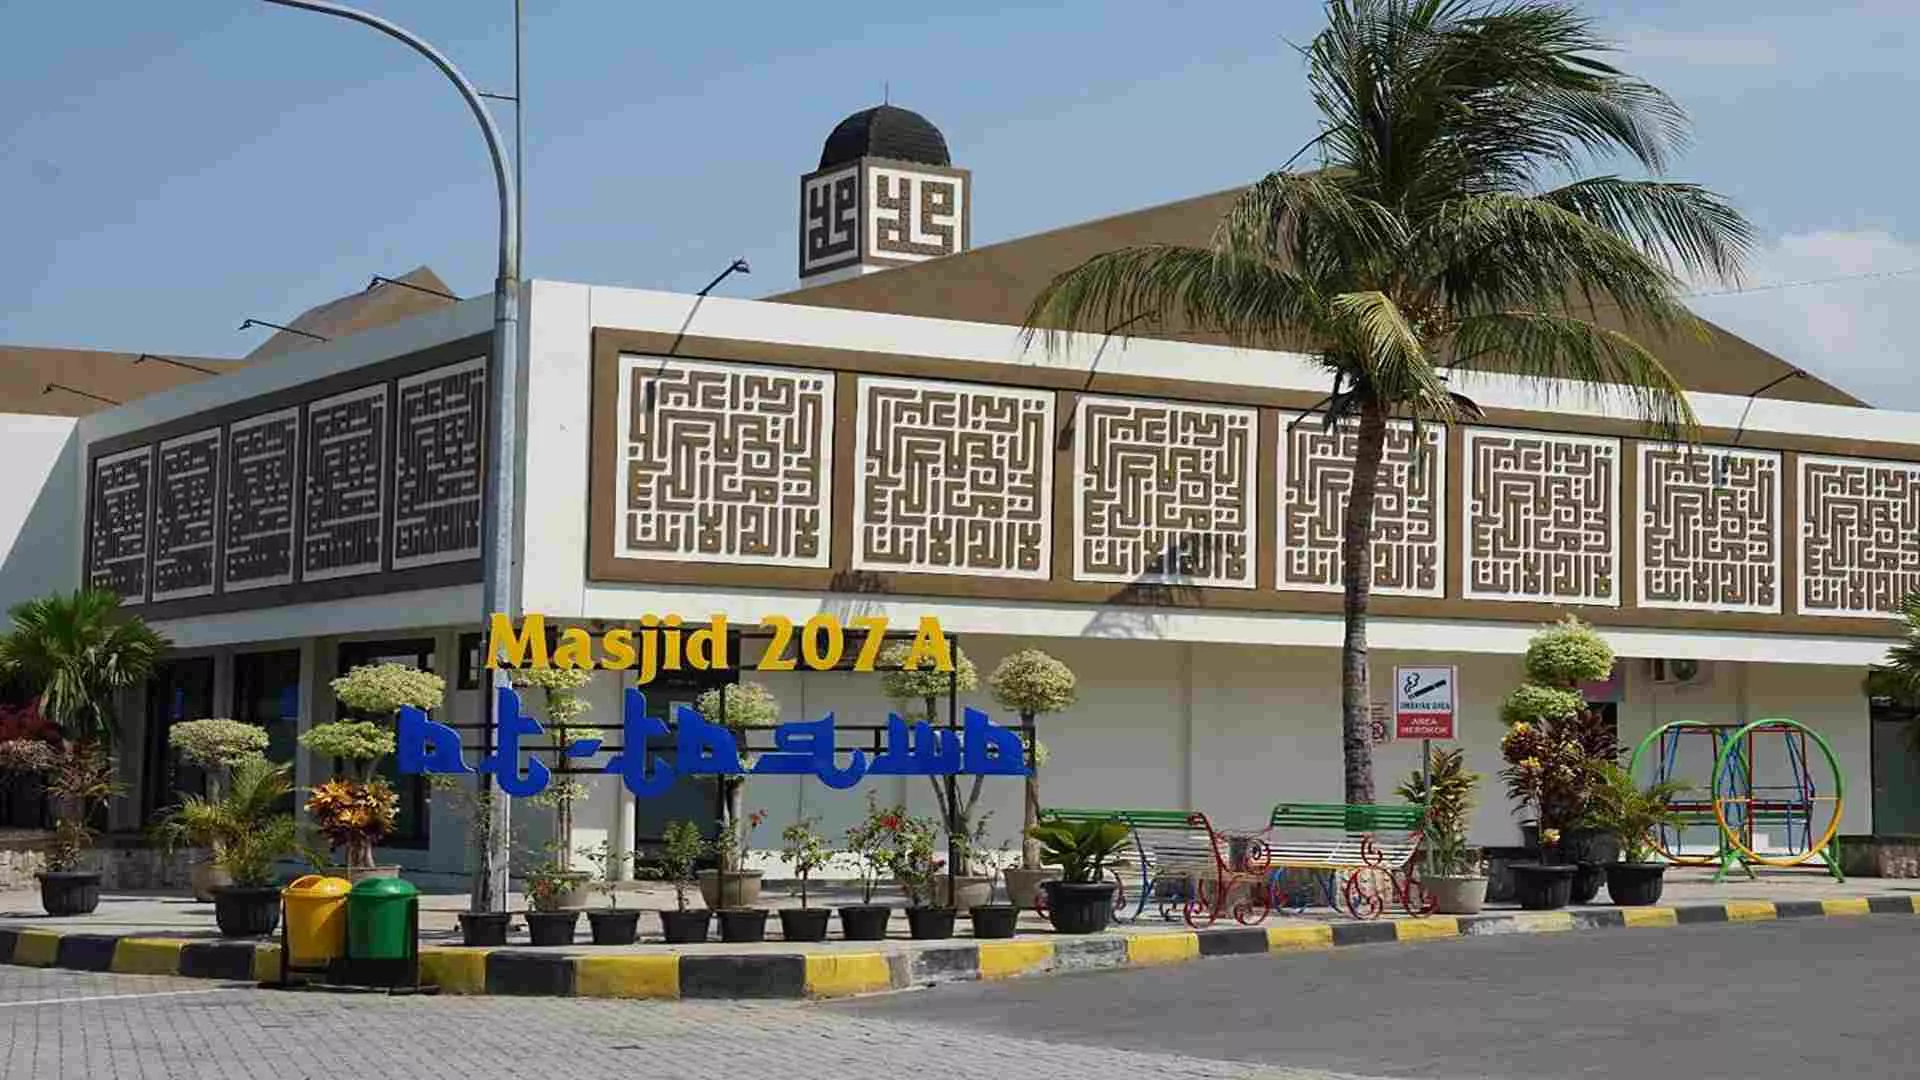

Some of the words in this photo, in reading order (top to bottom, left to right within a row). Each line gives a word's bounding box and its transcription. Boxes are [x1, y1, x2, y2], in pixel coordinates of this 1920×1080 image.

[485, 612, 730, 685] Masjid
[757, 615, 888, 672] 207
[903, 616, 955, 672] A
